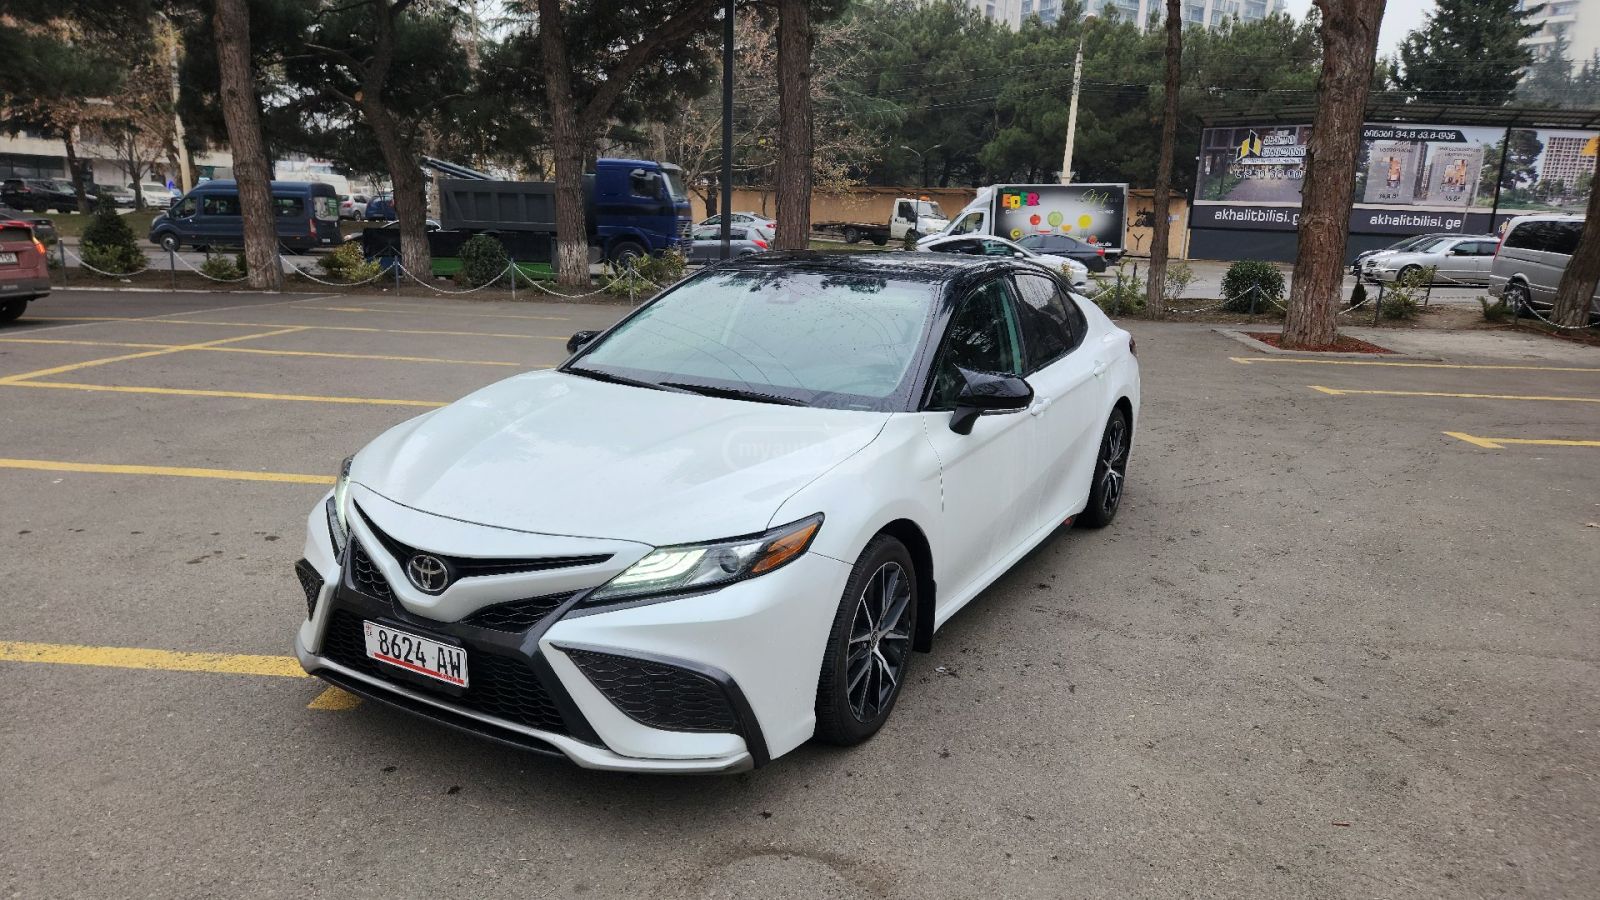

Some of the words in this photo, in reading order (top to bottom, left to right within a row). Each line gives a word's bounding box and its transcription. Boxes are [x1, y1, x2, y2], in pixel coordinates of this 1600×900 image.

[1002, 191, 1040, 209] EDER
[1214, 208, 1300, 226] akhalitbilisi.g
[1369, 213, 1462, 230] akhalitbilisi.ge
[378, 629, 427, 668] 8624
[437, 646, 461, 678] AW
